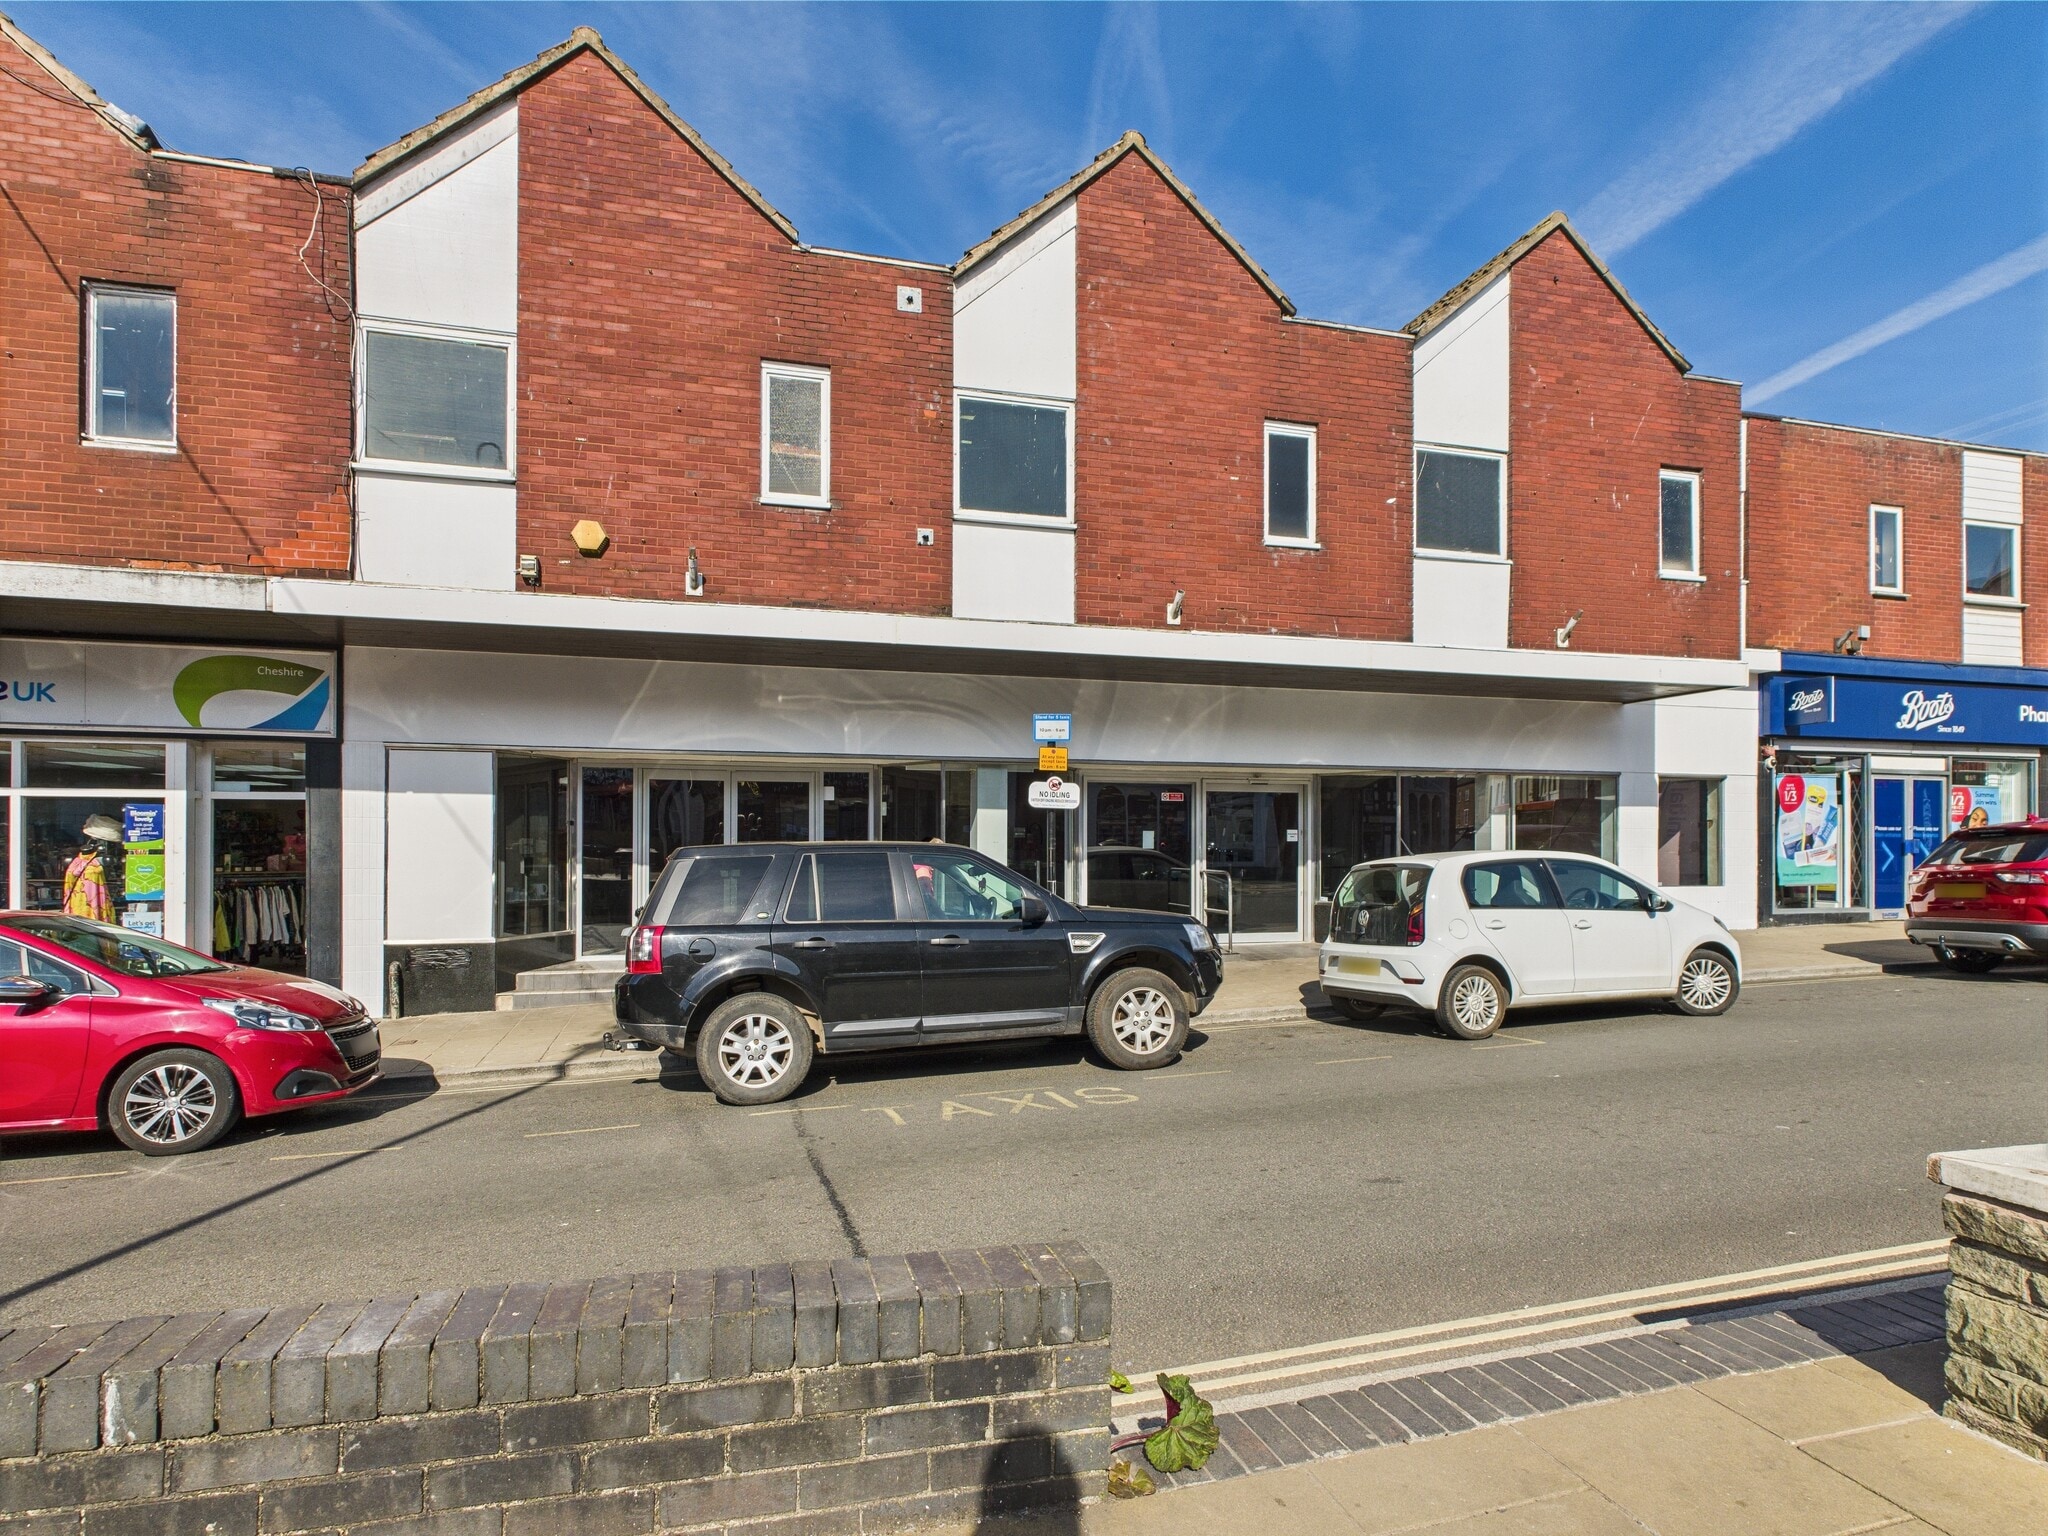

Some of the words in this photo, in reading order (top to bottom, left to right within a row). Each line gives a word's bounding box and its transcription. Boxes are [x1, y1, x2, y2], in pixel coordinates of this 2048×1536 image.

[257, 665, 304, 677] Cheshire
[1788, 689, 1824, 711] Boots
[1896, 690, 1955, 731] Boots
[1937, 725, 1952, 733] Since
[1049, 791, 1071, 799] IDLING
[1784, 790, 1797, 802] 1/3
[860, 1086, 1140, 1126] TAXIS
